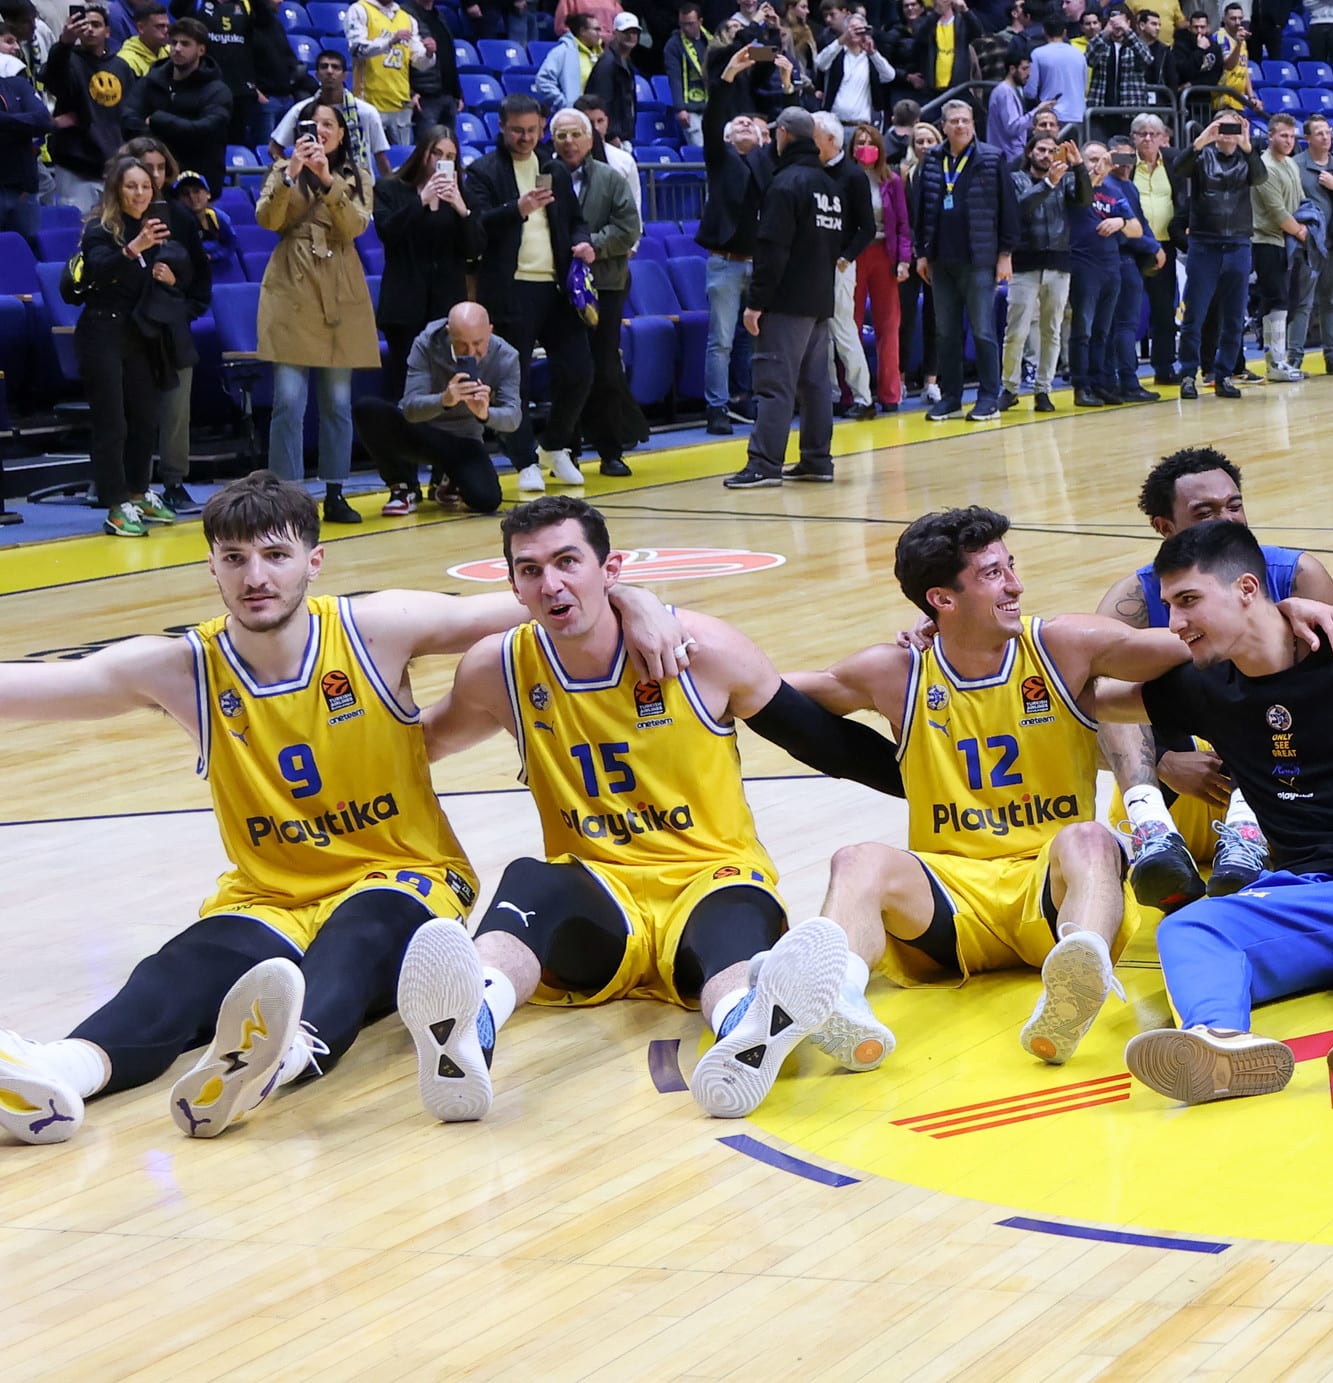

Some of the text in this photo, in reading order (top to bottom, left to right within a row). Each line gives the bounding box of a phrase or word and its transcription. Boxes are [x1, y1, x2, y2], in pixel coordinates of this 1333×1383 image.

[222, 16, 233, 32] 5
[329, 708, 365, 726] oneteam
[636, 717, 673, 730] oneteam
[1020, 715, 1056, 727] oneteam
[1272, 733, 1294, 741] ONLY
[1274, 741, 1290, 749] SEE
[957, 734, 1024, 790] 12
[1272, 749, 1297, 758] GREAT
[278, 744, 322, 799] 9
[570, 742, 636, 798] 15
[247, 792, 400, 848] Playtika
[932, 793, 1079, 837] Playtika
